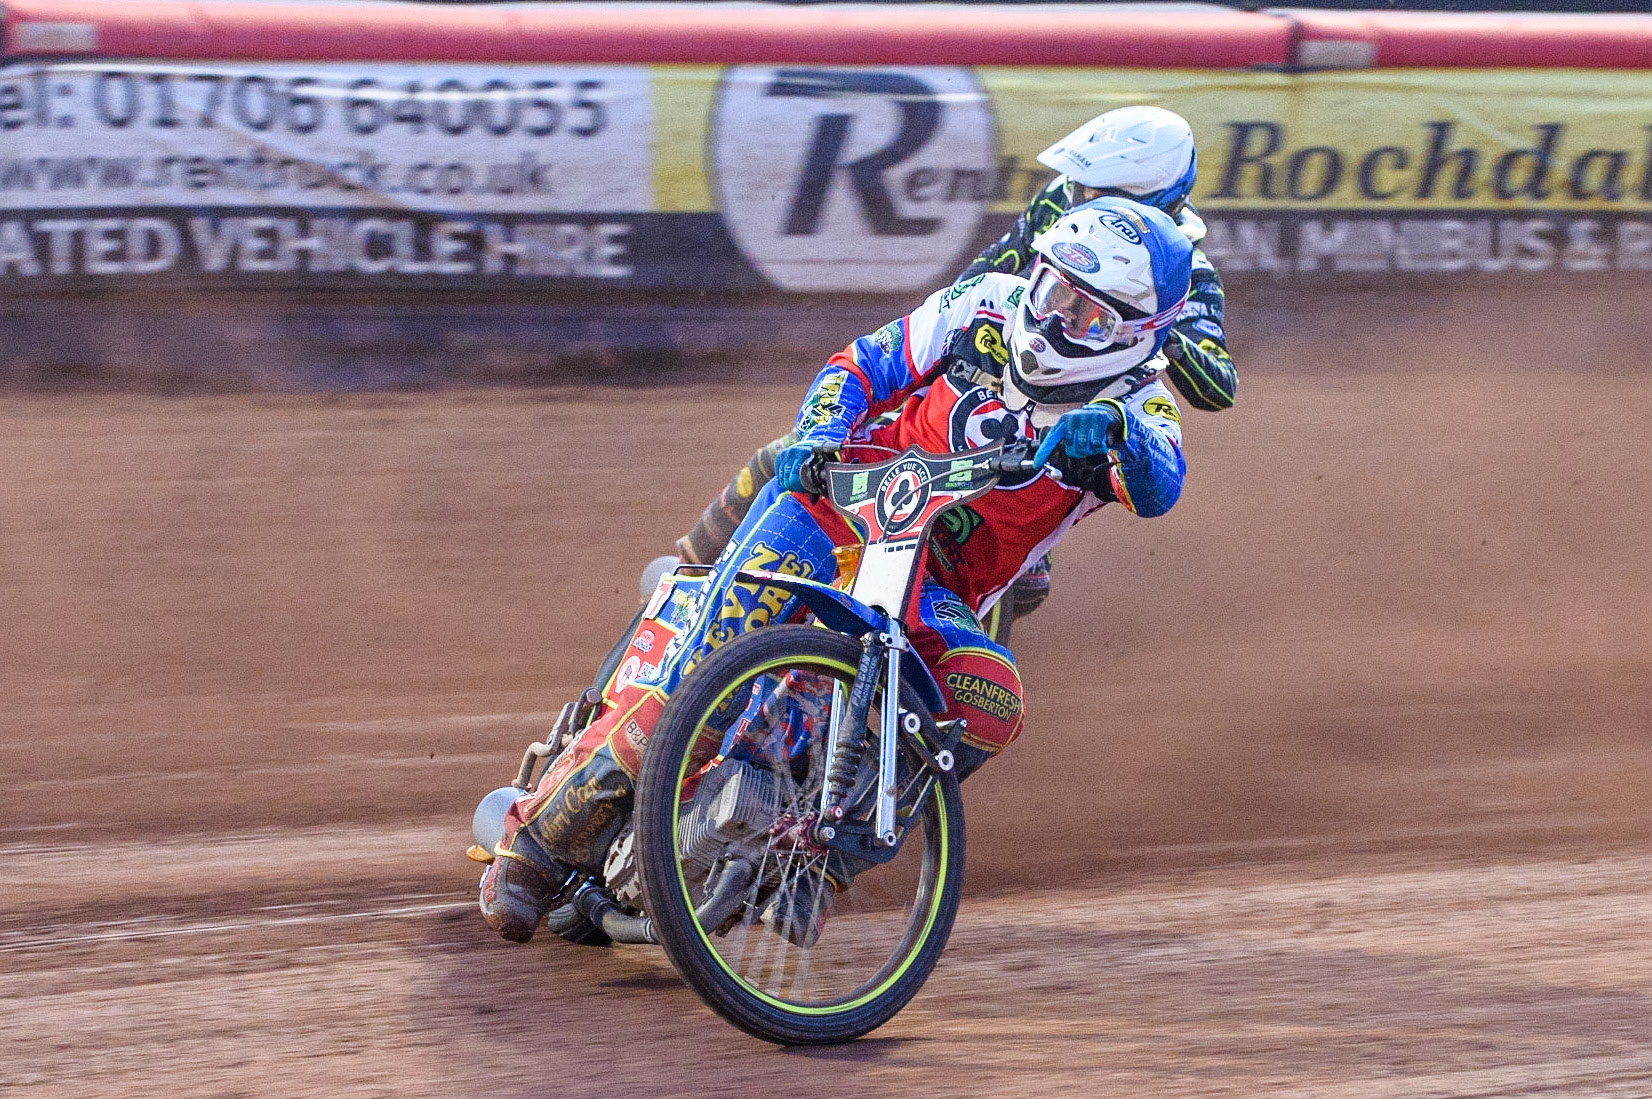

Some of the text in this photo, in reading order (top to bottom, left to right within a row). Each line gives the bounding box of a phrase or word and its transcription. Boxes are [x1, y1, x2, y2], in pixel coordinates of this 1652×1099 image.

[94, 70, 324, 133] 01706
[345, 78, 608, 137] 640055
[188, 217, 476, 276] VEHICLE
[1110, 218, 1138, 241] Arai
[881, 467, 900, 492] BELLE
[903, 462, 917, 472] VUE
[946, 673, 1020, 714] CLEANFRESH
[954, 690, 1012, 721] GOSBERTON
